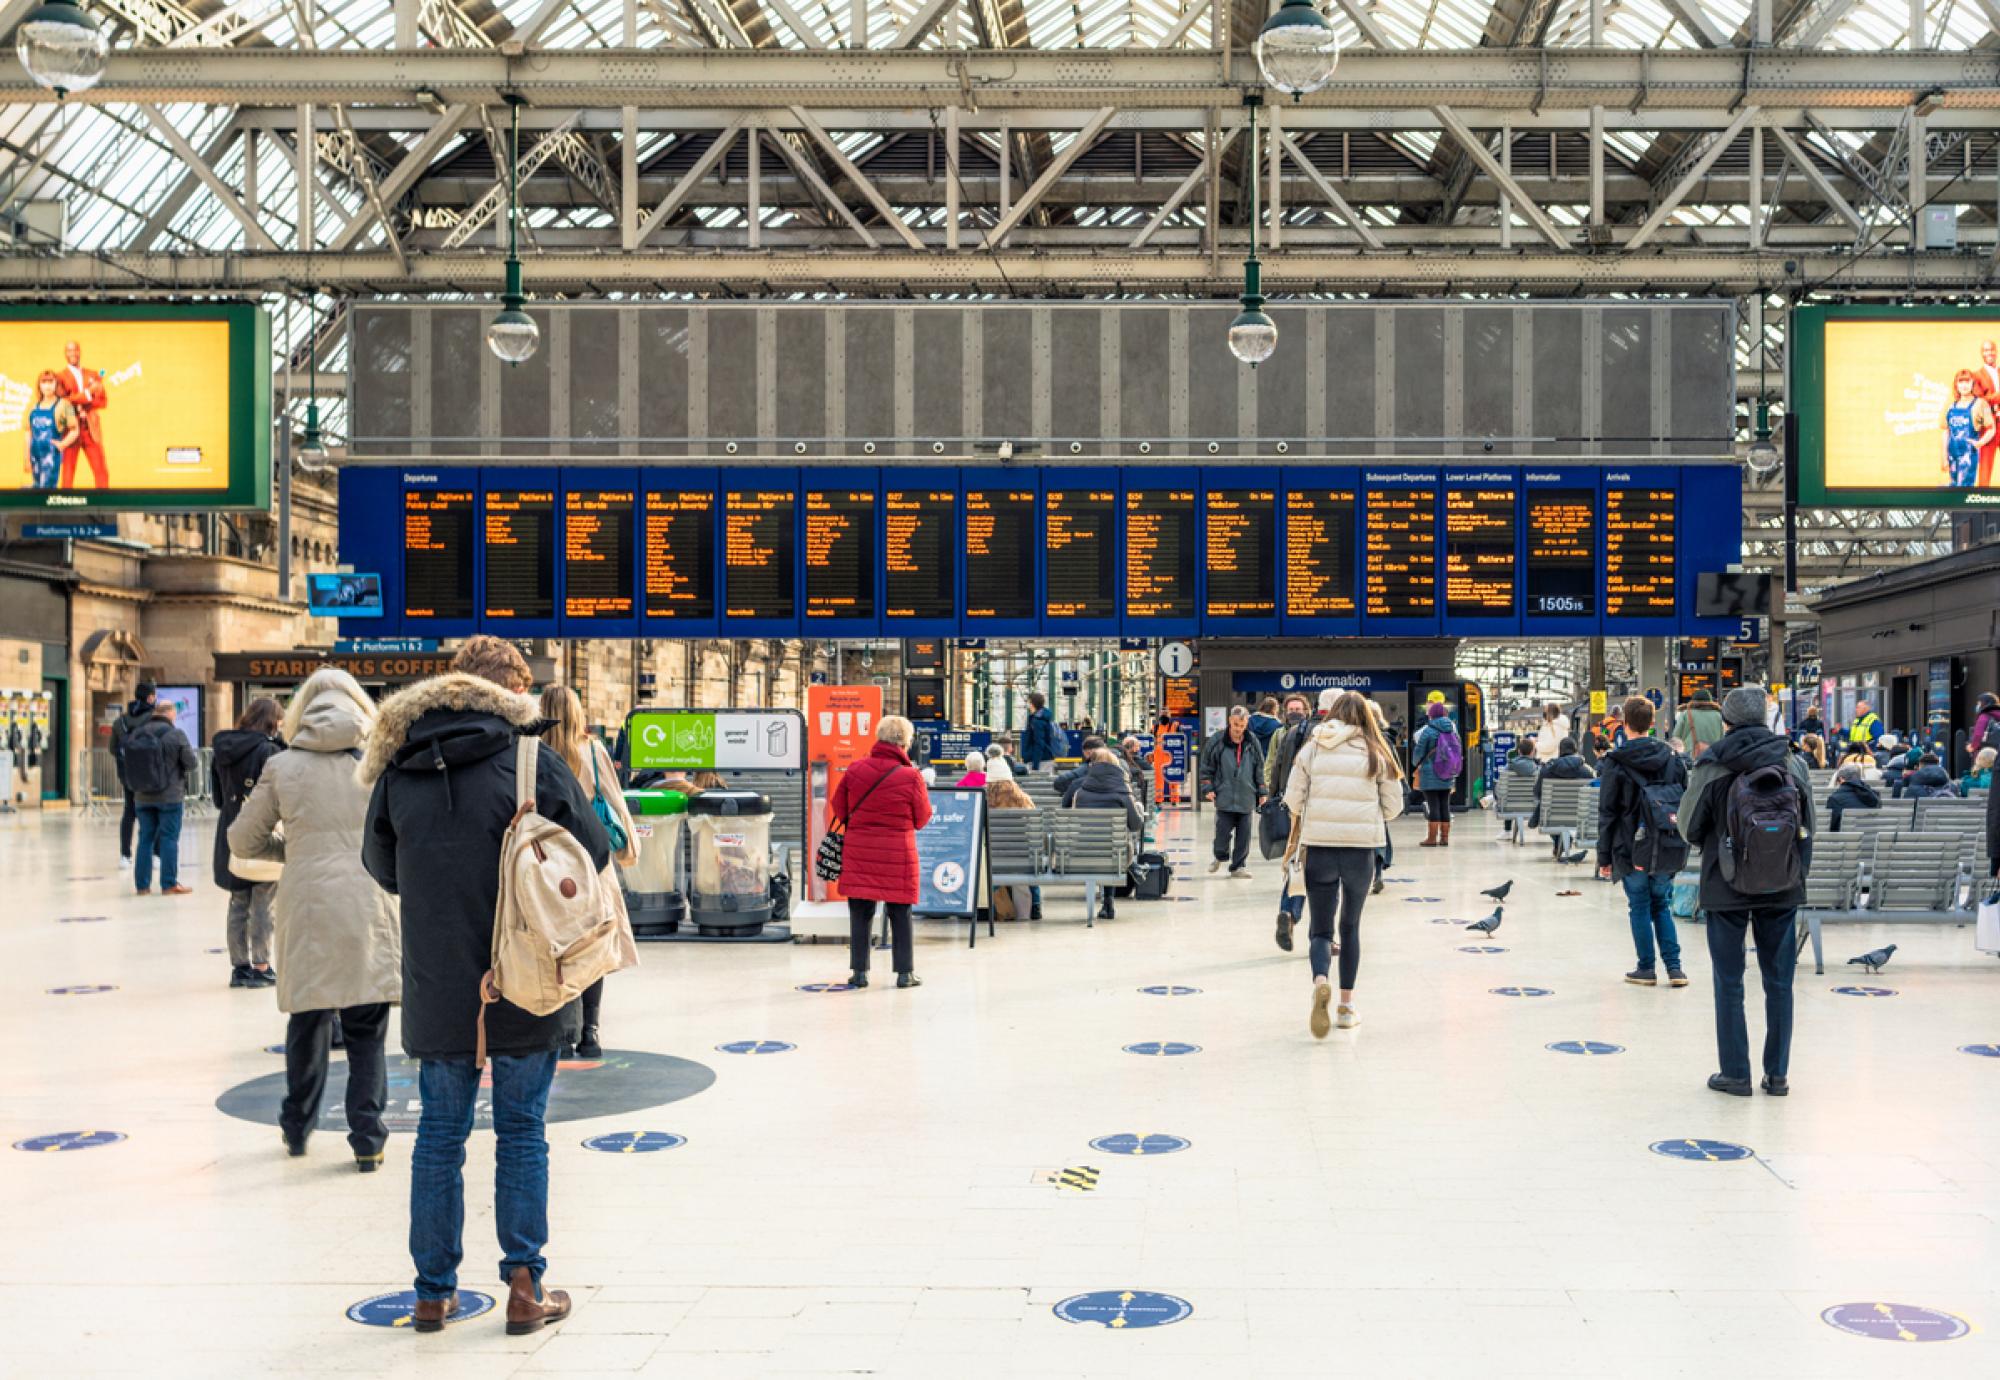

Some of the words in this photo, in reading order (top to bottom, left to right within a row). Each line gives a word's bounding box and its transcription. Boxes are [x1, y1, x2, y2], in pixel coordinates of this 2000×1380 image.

[403, 473, 438, 484] Departures
[1366, 473, 1402, 484] Subsequent
[1403, 473, 1436, 484] Departures
[1446, 473, 1466, 482] Lower
[1466, 473, 1482, 482] Level
[1483, 473, 1512, 482] Platforms
[1526, 473, 1561, 482] Information
[1607, 473, 1631, 482] Arrivals
[1539, 597, 1573, 611] 1505
[1739, 621, 1752, 641] 5
[363, 642, 400, 652] Platforms
[408, 642, 415, 651] &
[416, 642, 423, 651] 2
[1300, 674, 1371, 687] Information
[724, 729, 749, 738] general
[643, 756, 654, 765] dry
[656, 756, 674, 764] mixed
[675, 756, 703, 765] recycling
[943, 814, 966, 823] safer
